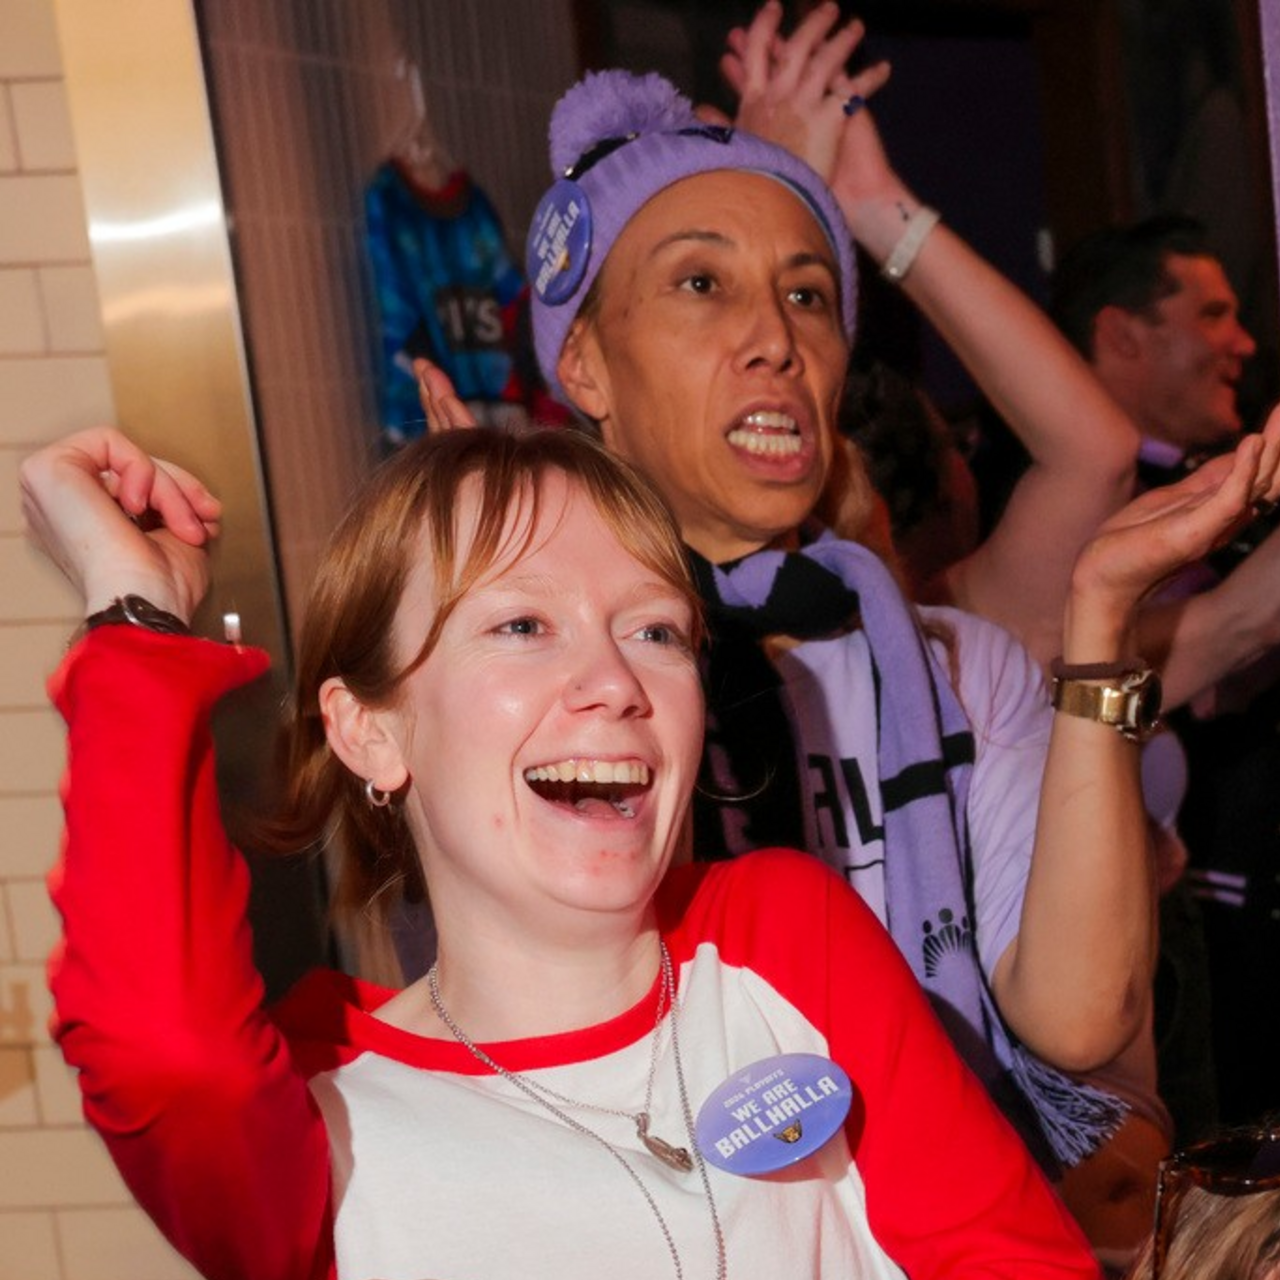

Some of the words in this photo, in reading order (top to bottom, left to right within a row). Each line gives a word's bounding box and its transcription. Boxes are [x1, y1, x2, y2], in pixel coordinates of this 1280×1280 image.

[714, 1075, 840, 1160] BALLHALLA
[731, 1099, 762, 1122] WE
[762, 1078, 799, 1106] ARE
